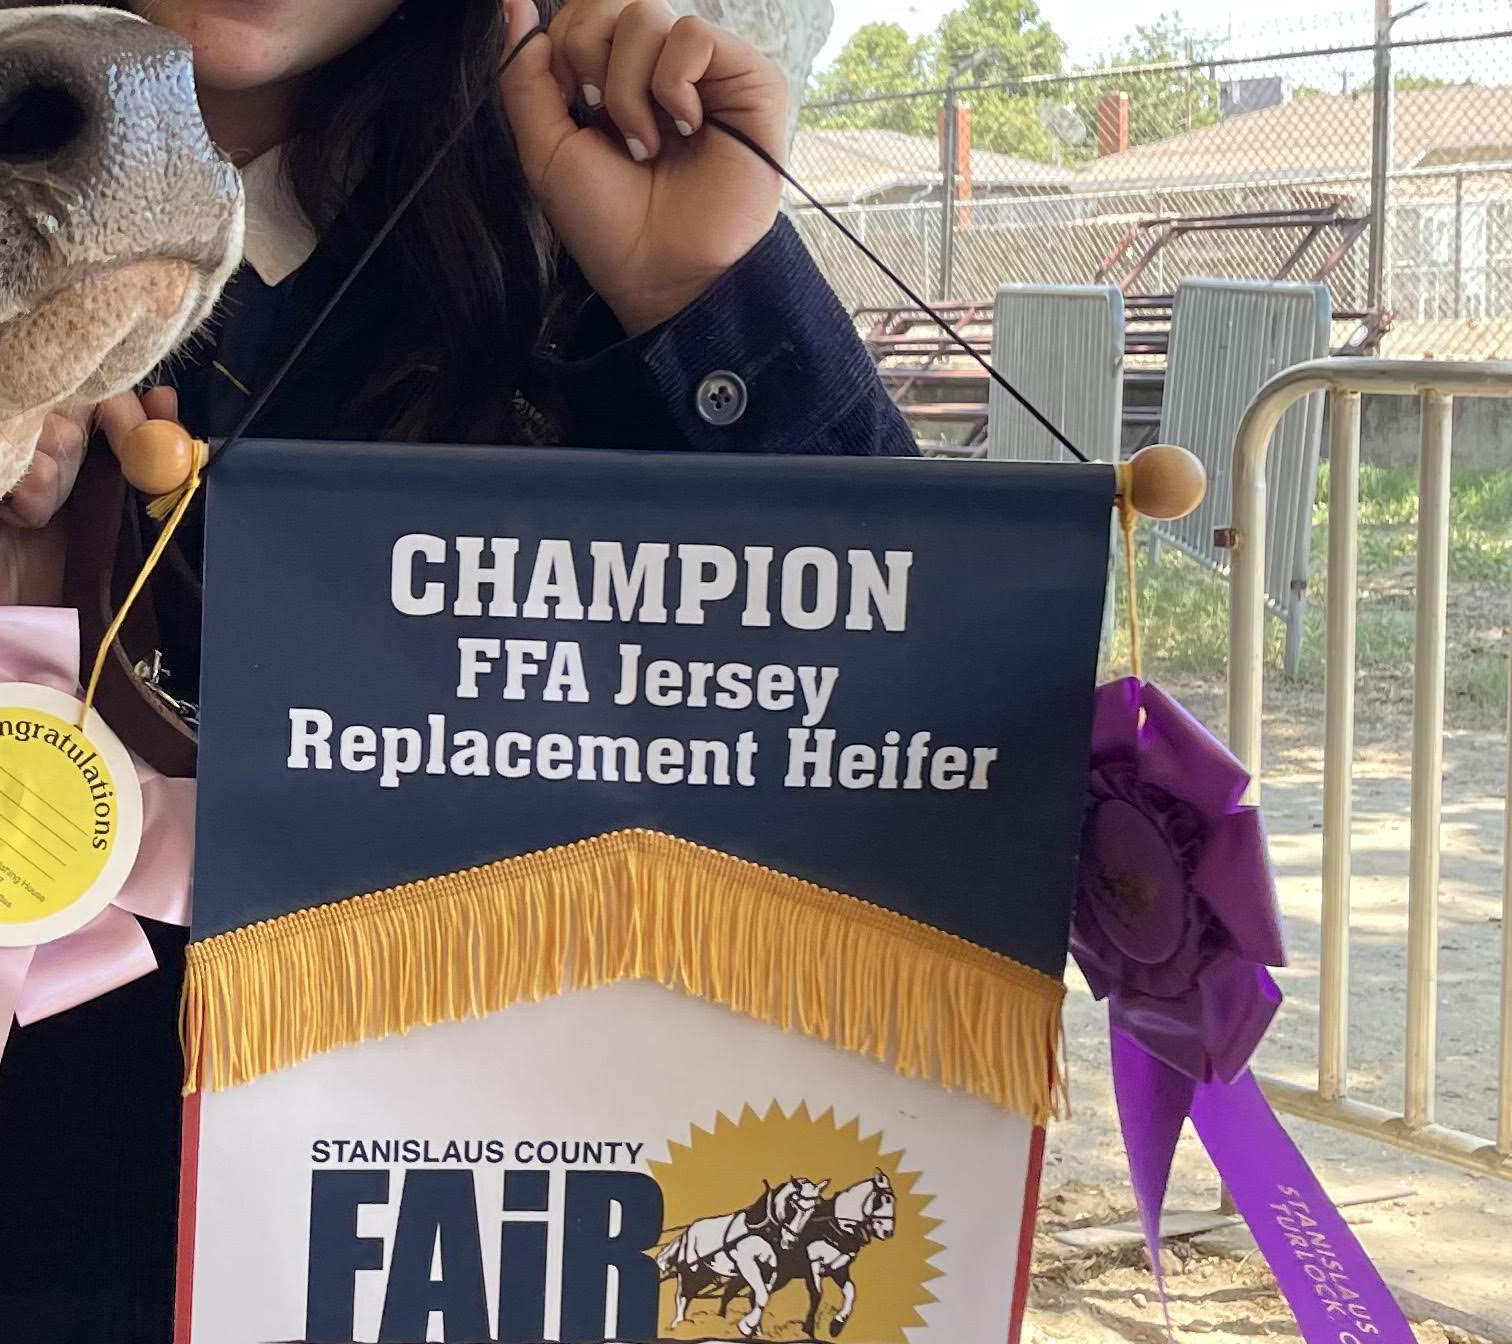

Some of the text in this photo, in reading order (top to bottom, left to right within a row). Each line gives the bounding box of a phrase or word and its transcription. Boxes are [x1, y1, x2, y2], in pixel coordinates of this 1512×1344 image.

[389, 533, 914, 632] CHAMPION
[455, 637, 840, 727] FFA Jersey
[287, 708, 999, 791] Replacement Heifer
[311, 1140, 644, 1165] STANISLAUS COUNTY
[1277, 1183, 1379, 1336] STANISLAUS
